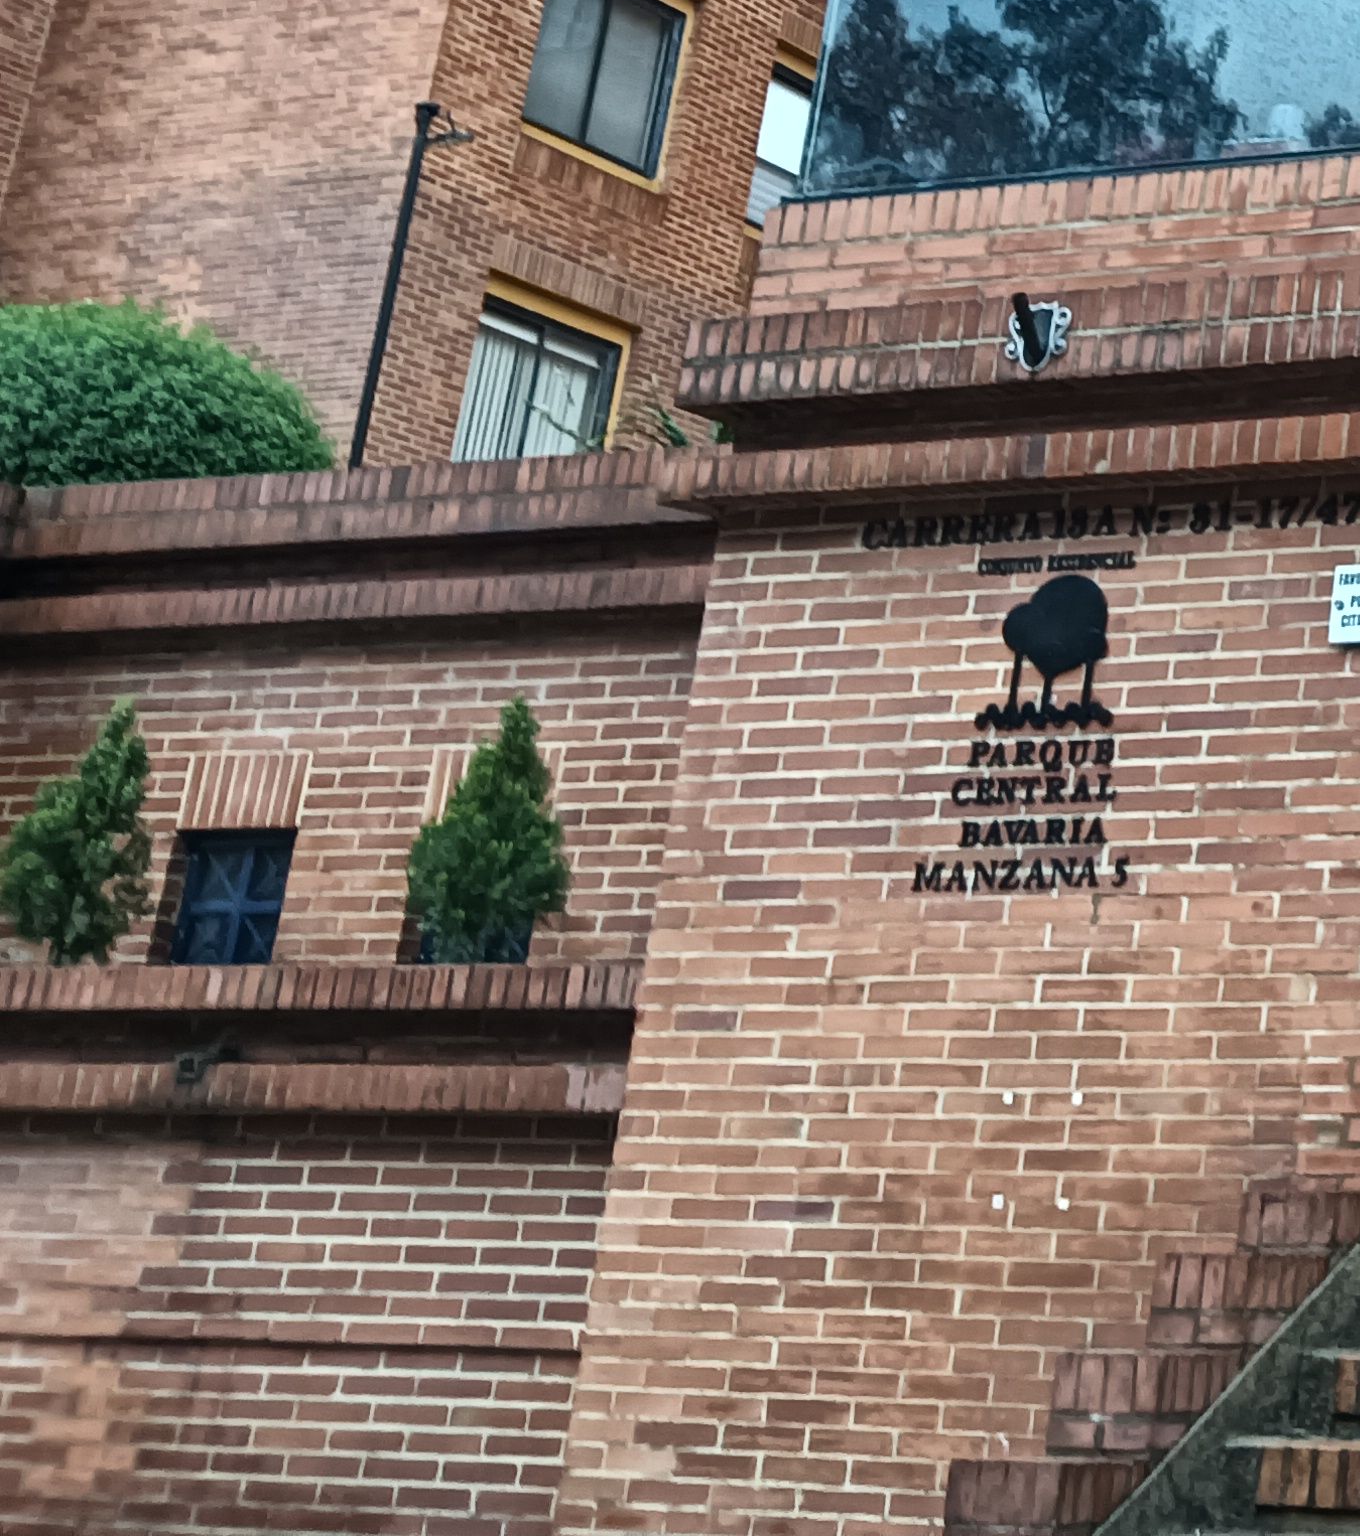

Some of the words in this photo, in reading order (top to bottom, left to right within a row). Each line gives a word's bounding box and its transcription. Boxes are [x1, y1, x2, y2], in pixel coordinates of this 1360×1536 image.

[861, 510, 1041, 550] CARRERA
[966, 738, 1116, 772] PARQUE
[951, 773, 1118, 806] CENTRAL
[958, 816, 1108, 848] BAVARIA
[910, 856, 1100, 893] MANZANA
[1111, 854, 1131, 888] 5
